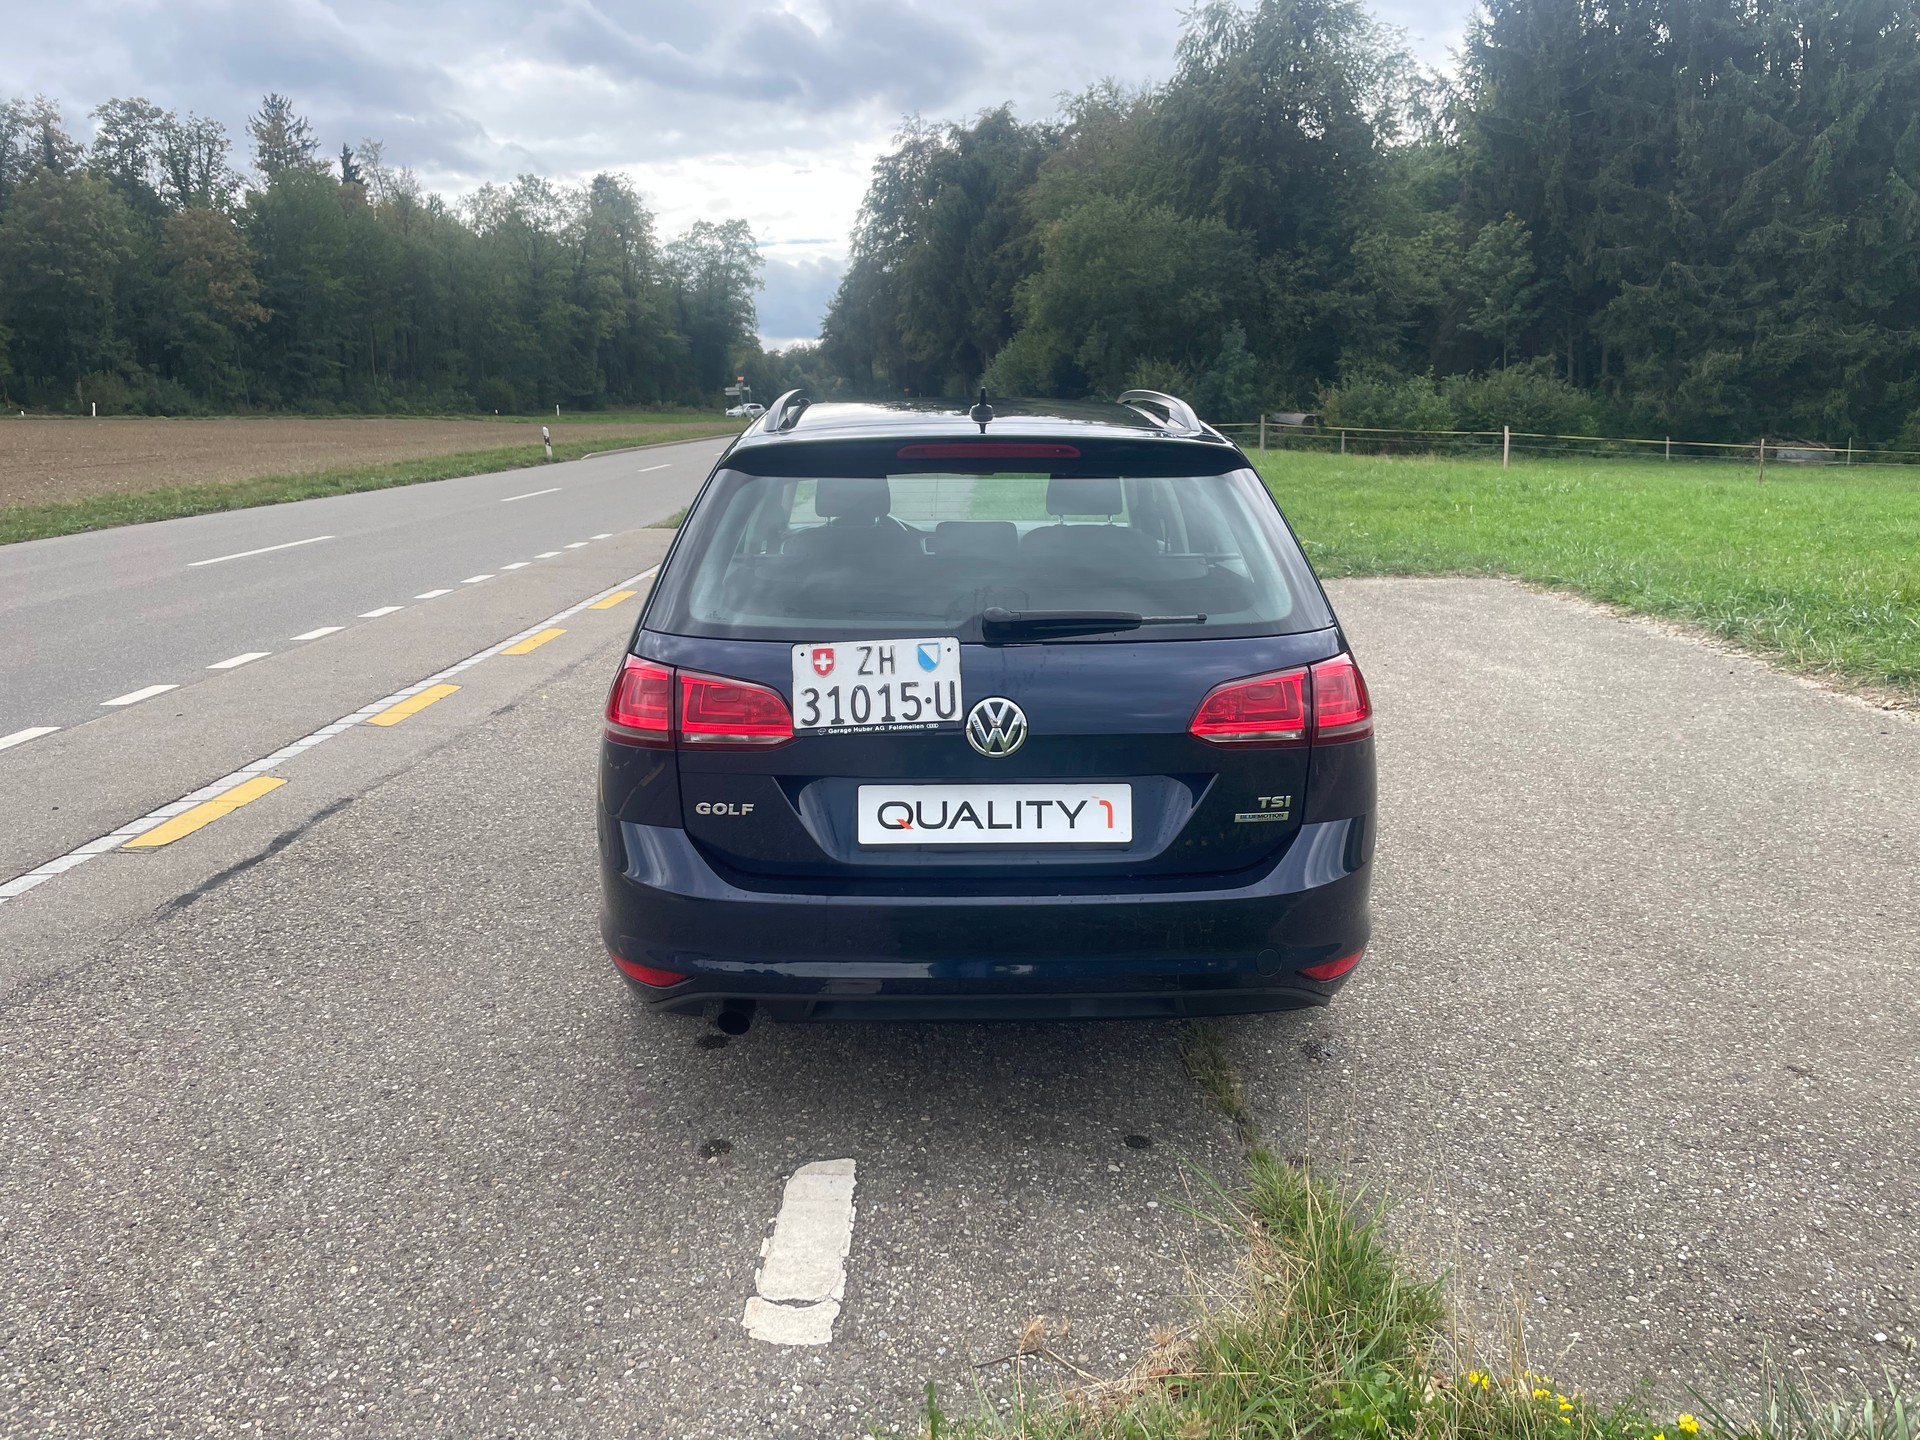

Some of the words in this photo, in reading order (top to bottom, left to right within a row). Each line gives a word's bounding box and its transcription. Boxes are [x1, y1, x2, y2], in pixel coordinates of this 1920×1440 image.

[857, 645, 896, 675] ZH
[968, 699, 1026, 756] VW
[695, 802, 754, 815] GOLF
[1258, 795, 1291, 809] TSI
